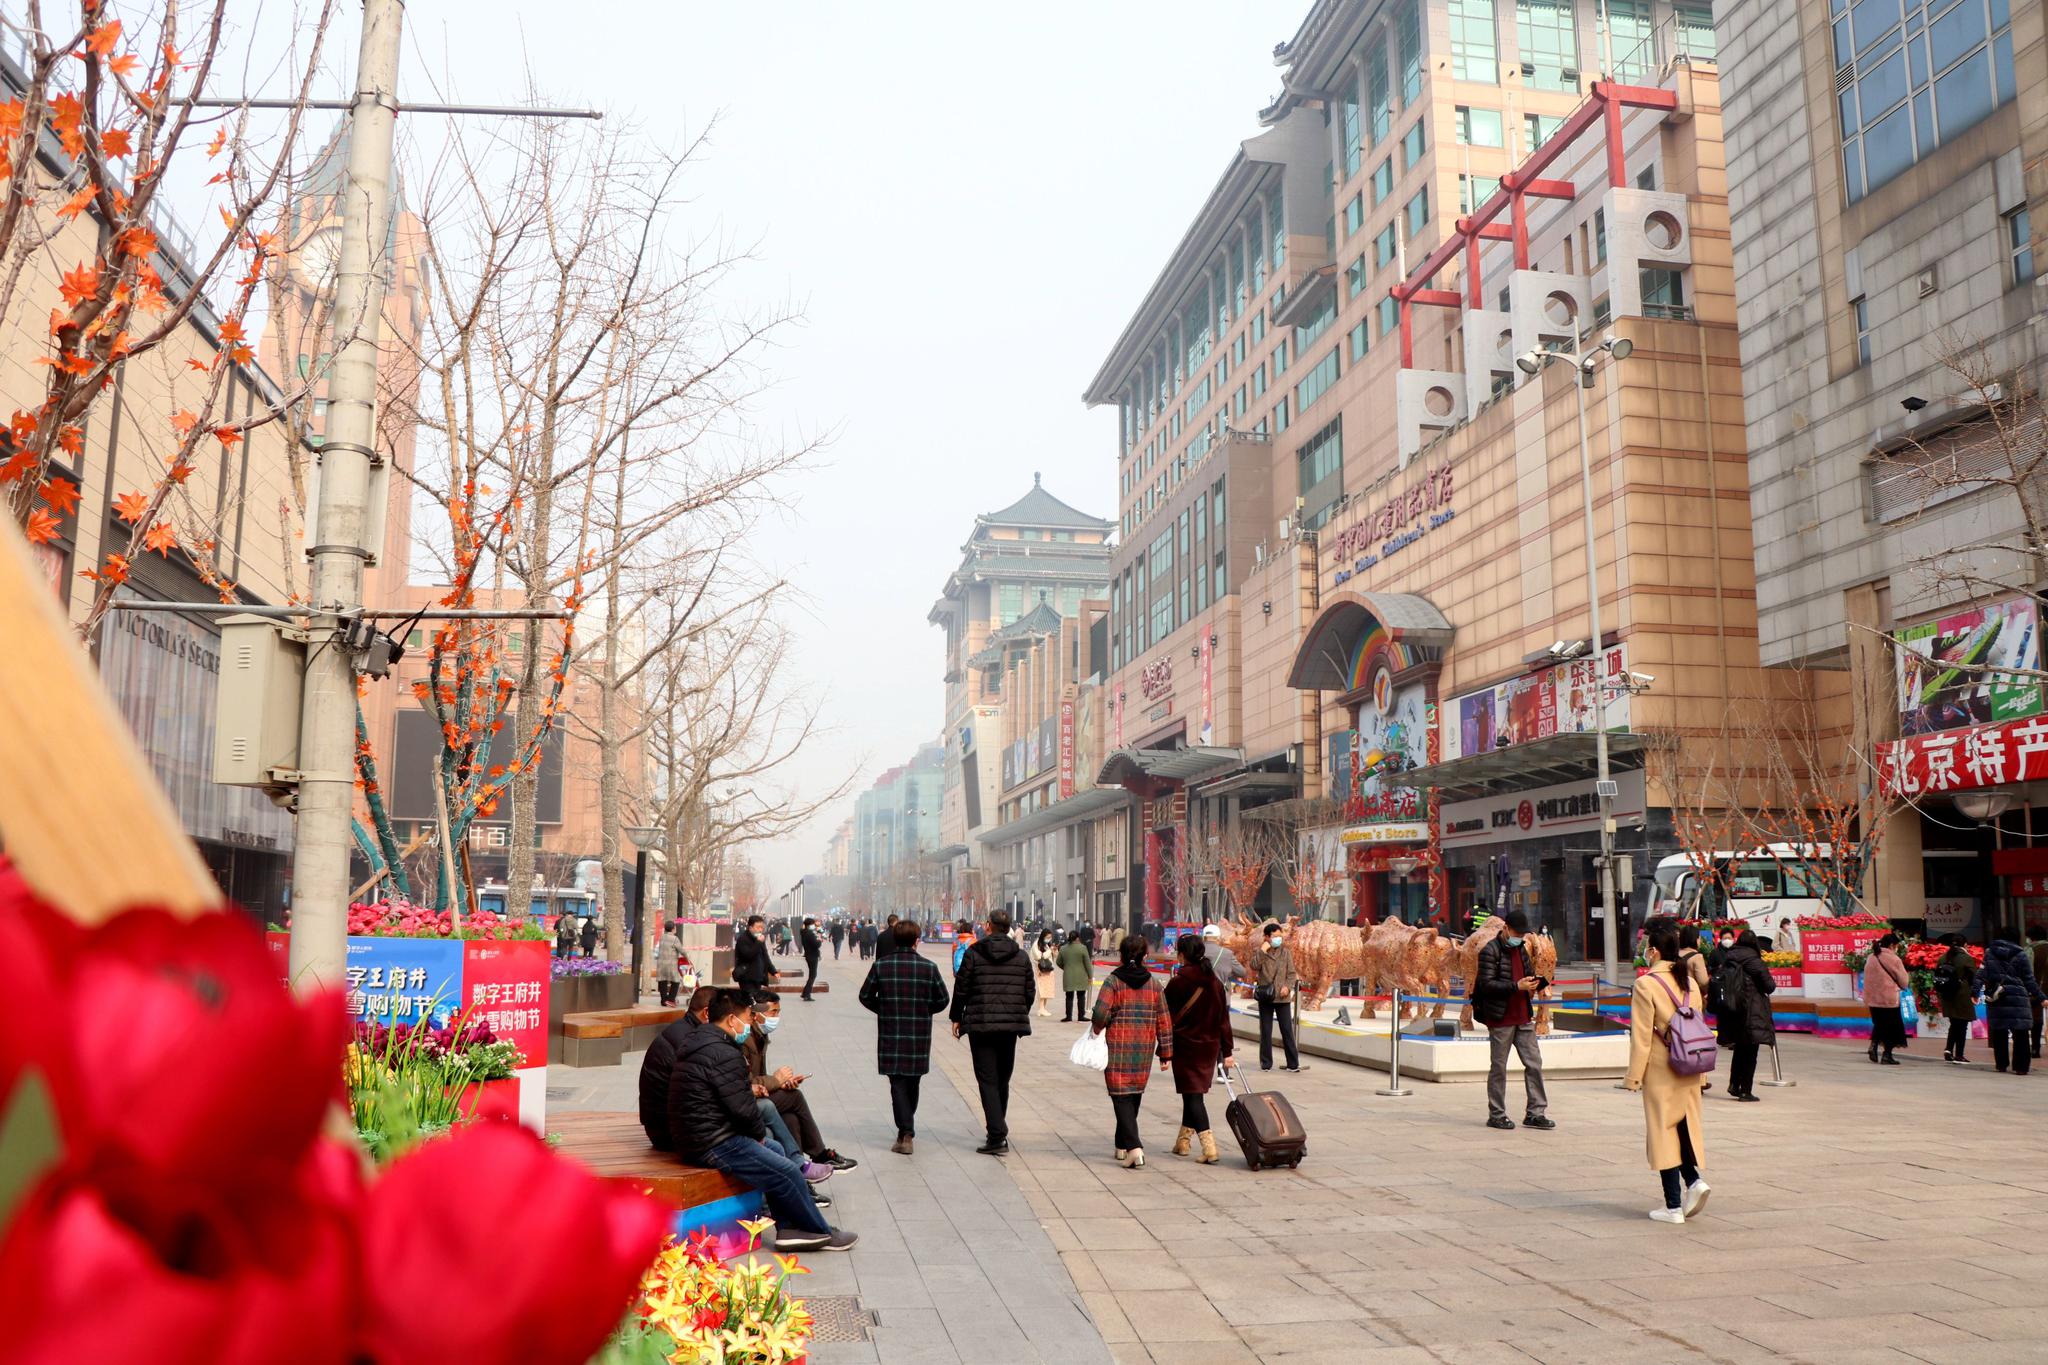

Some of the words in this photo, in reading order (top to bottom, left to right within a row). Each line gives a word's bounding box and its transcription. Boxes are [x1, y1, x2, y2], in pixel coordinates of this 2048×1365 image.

[117, 607, 186, 658] VICTORIA'S
[188, 640, 220, 676] SECRE
[978, 710, 999, 719] apm
[1886, 718, 2048, 793] 北京特产
[1491, 807, 1517, 828] ICBC
[1385, 827, 1418, 839] Store
[1808, 944, 1844, 953] 魅力王府井
[346, 965, 427, 990] 字王府井
[346, 992, 435, 1017] 雪购物节
[473, 981, 541, 1005] 数字王府井
